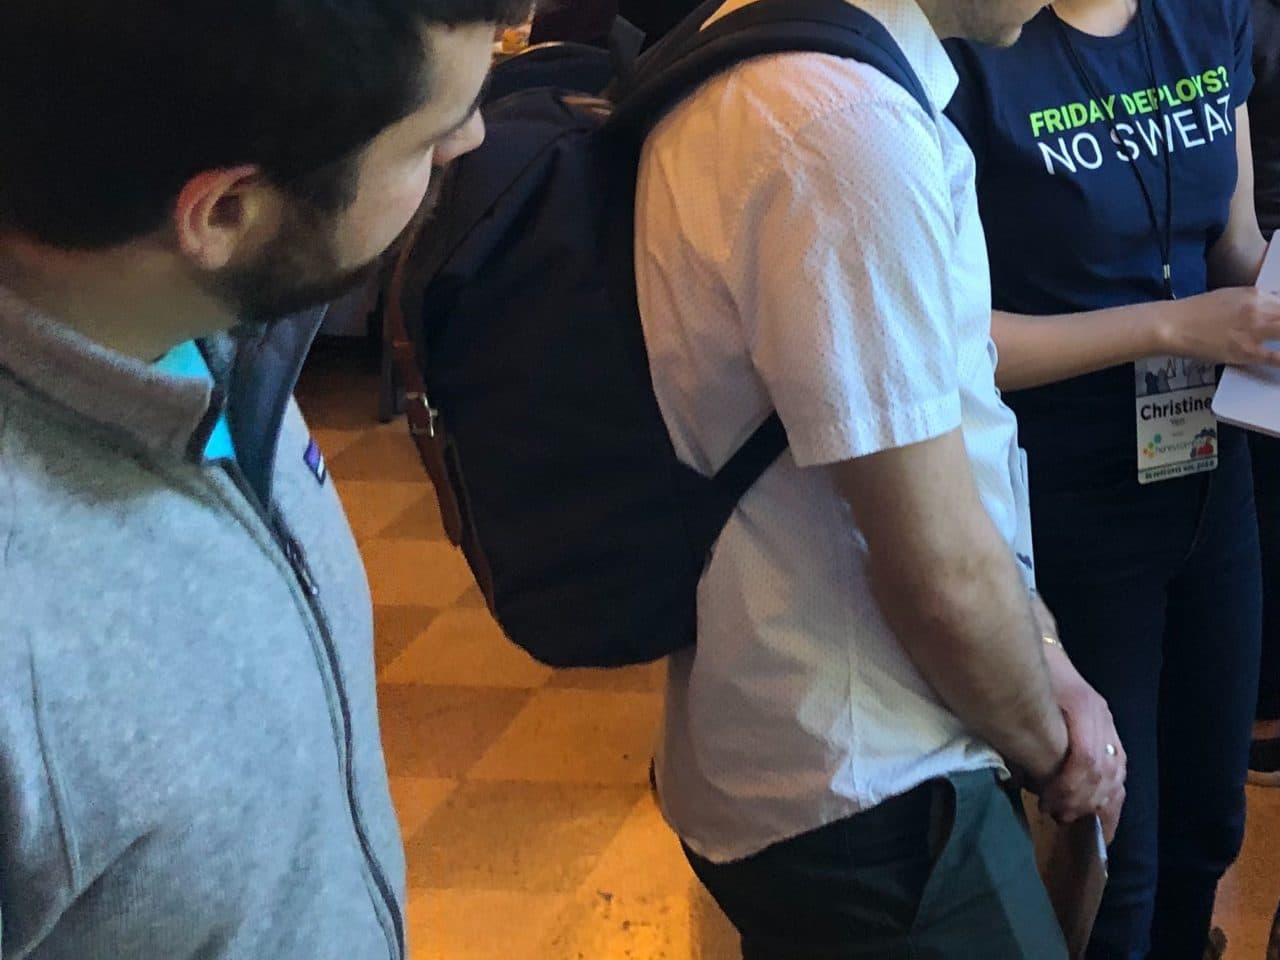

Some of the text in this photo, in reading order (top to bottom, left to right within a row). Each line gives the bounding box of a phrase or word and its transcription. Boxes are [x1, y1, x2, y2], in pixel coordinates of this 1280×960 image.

[1029, 65, 1230, 138] FRIDAY DEPLOYS?
[1037, 93, 1233, 175] NO SWEAT
